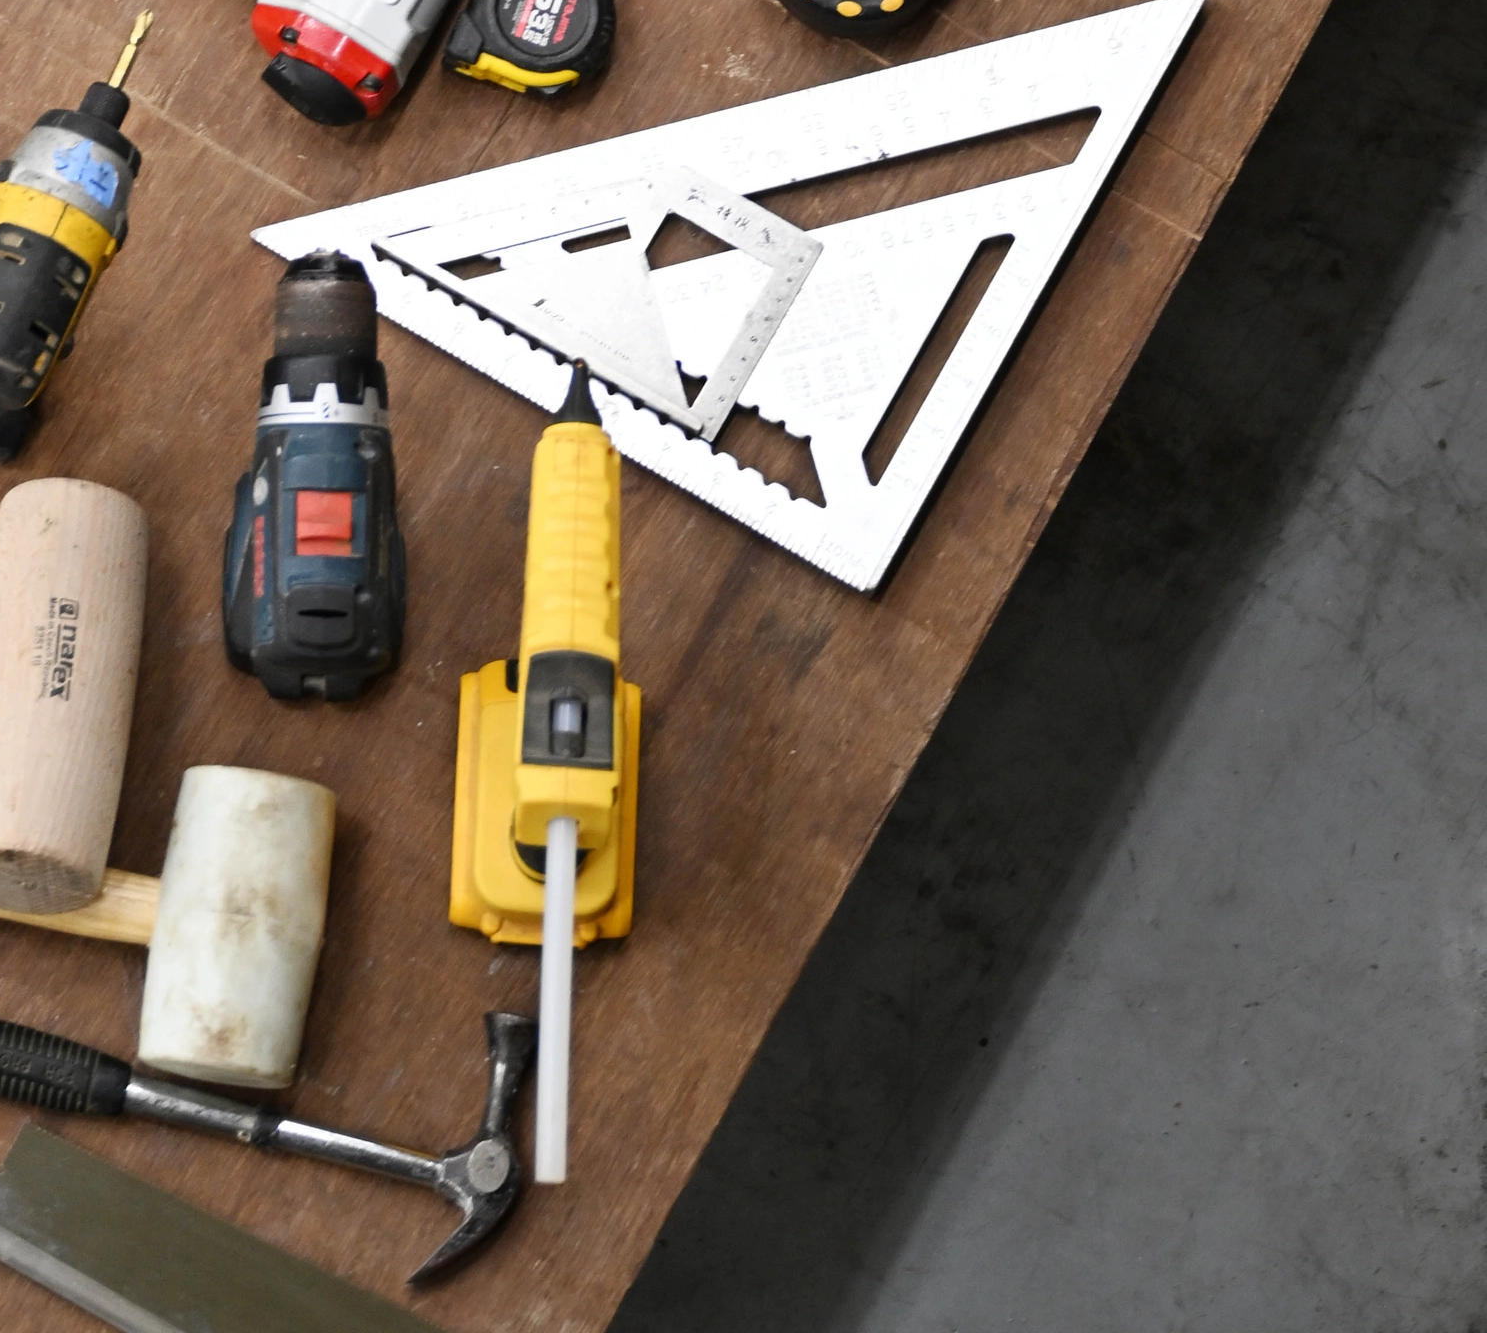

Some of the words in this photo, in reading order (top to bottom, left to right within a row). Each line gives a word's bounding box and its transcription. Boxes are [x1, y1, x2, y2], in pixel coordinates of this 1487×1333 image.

[661, 281, 691, 305] 30
[698, 272, 727, 295] 24
[48, 596, 57, 619] Made
[47, 620, 55, 629] in
[44, 630, 54, 658] Czech
[49, 623, 78, 701] narex
